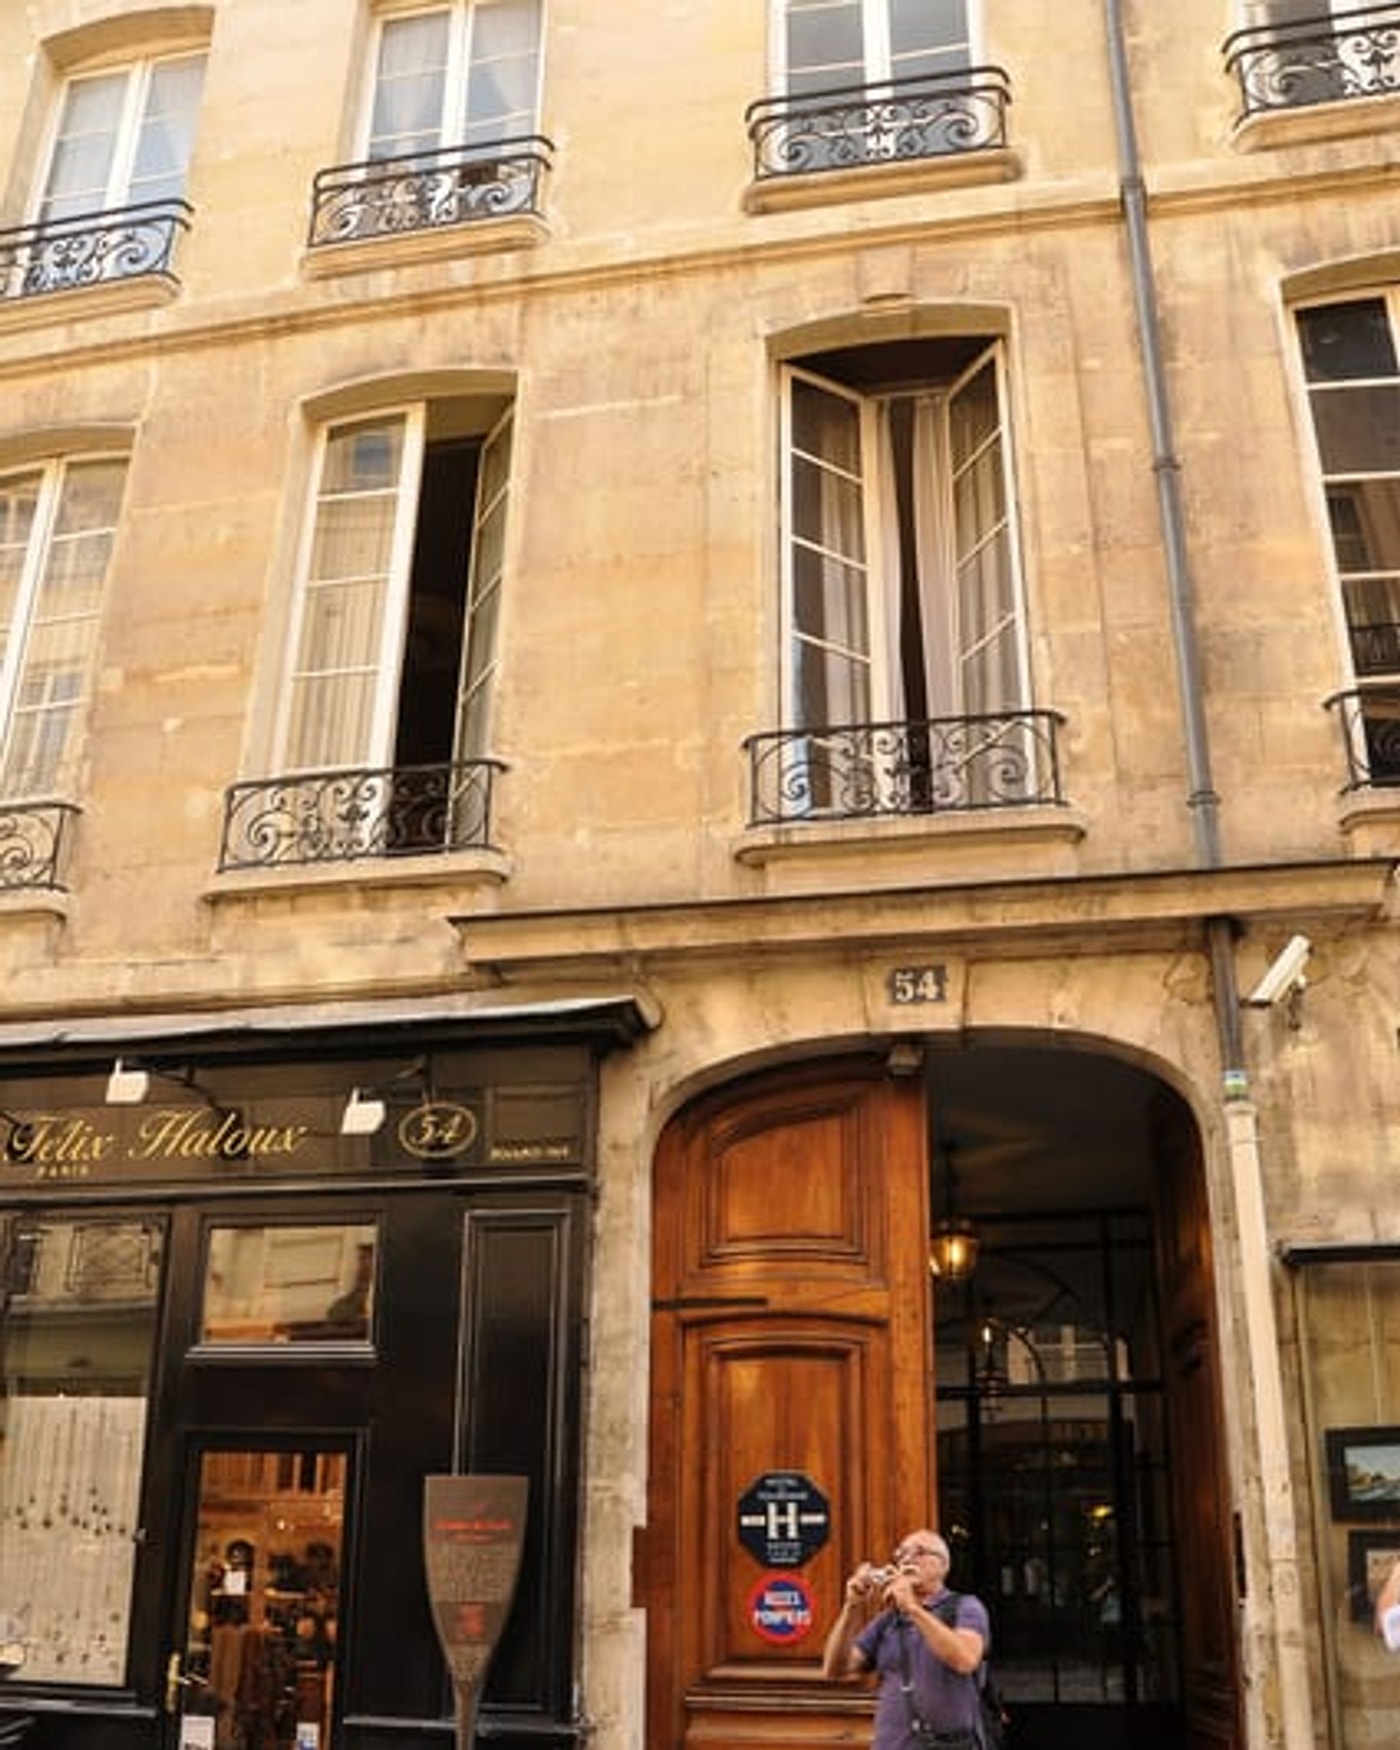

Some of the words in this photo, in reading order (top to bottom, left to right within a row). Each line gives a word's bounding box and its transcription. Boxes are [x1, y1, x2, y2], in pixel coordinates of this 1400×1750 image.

[895, 970, 938, 1003] 54
[410, 1113, 463, 1145] 54
[766, 1501, 799, 1540] H
